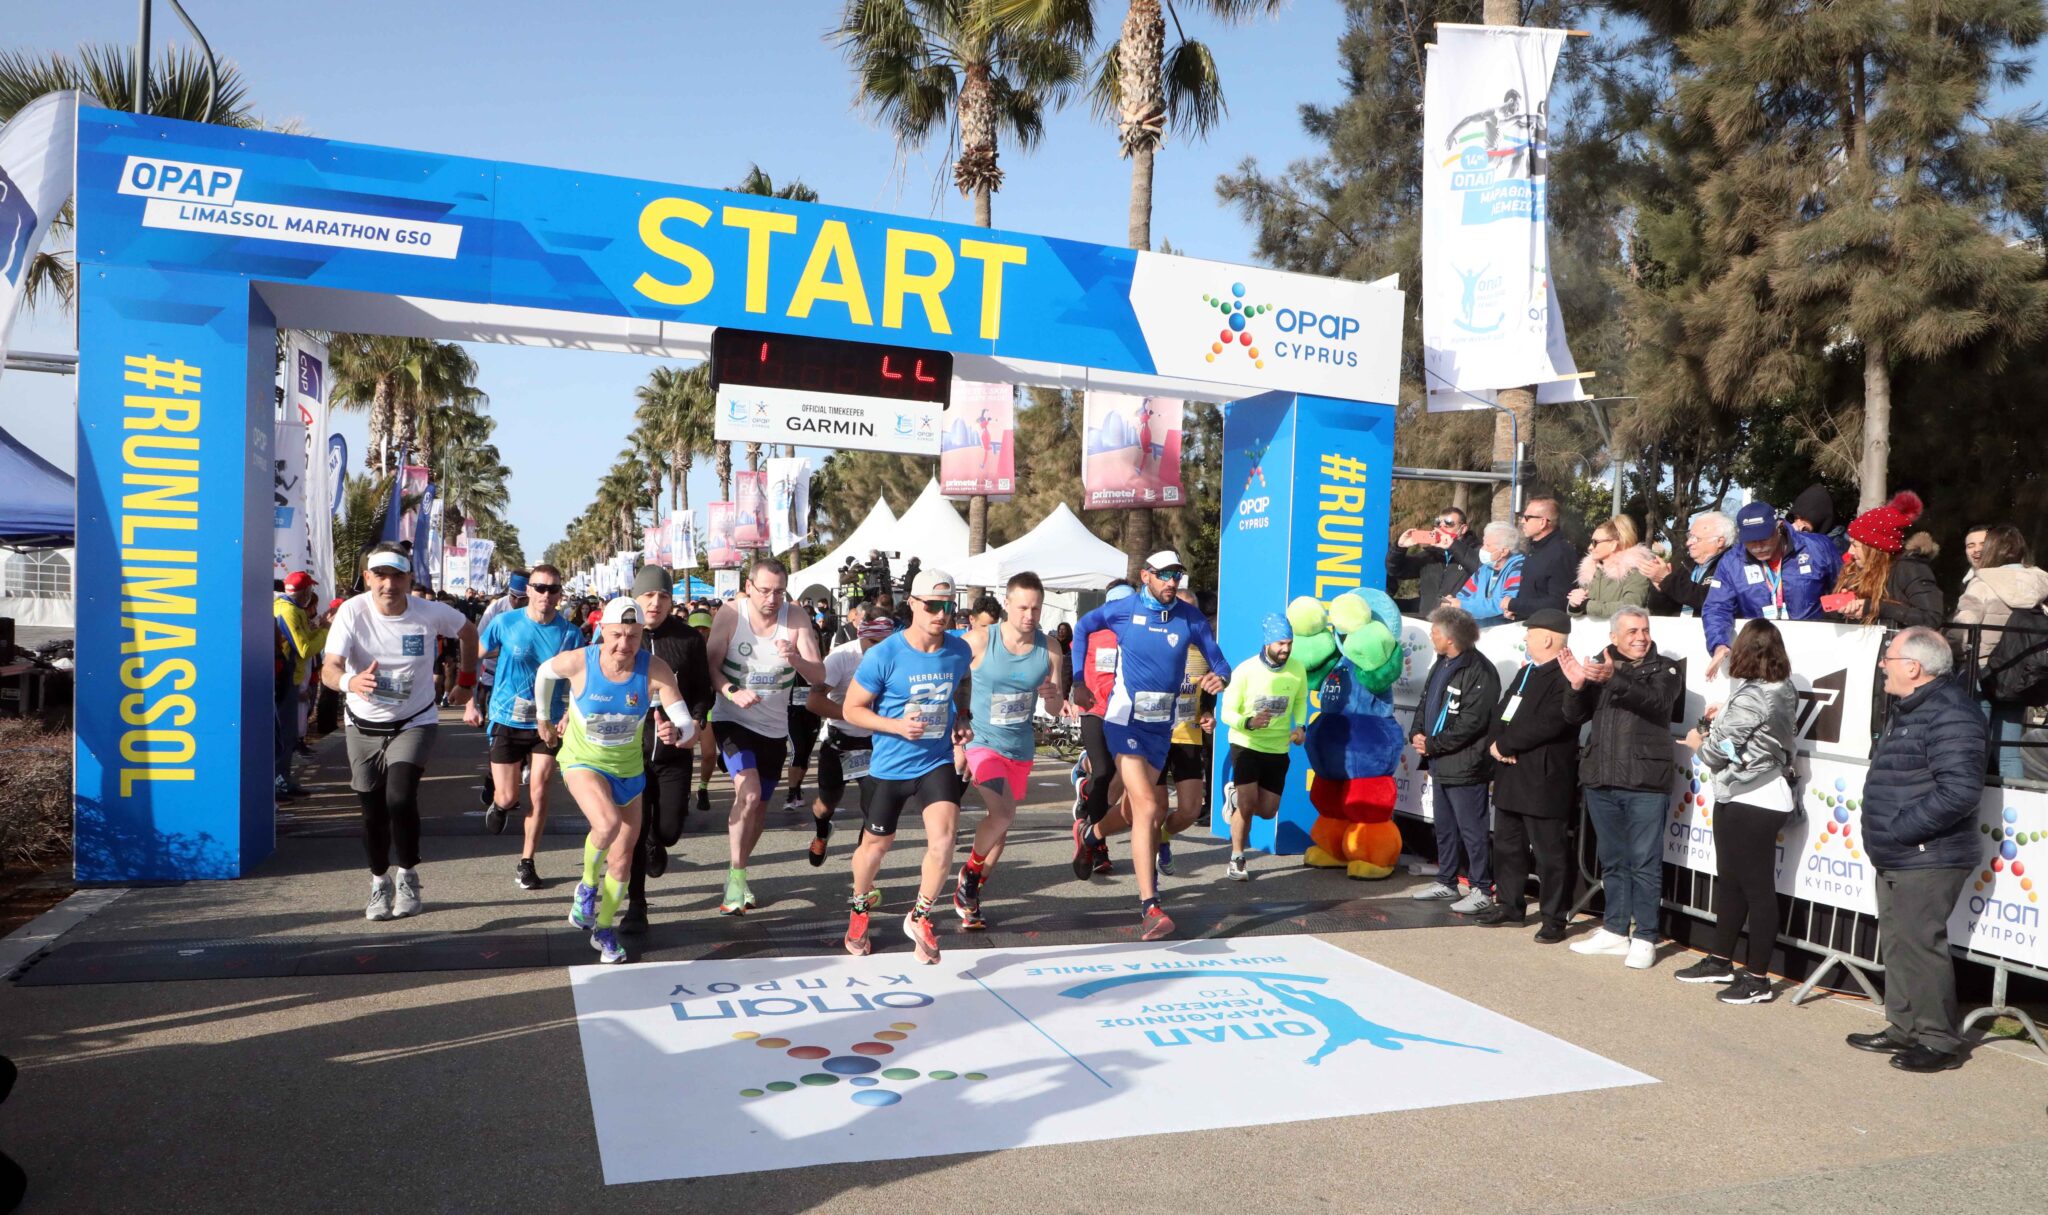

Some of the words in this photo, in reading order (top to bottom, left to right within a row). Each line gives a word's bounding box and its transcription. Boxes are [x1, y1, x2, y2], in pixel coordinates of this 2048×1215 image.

[131, 162, 233, 198] OPAP
[179, 205, 279, 230] LIMASSOL
[284, 216, 390, 242] MARATHON
[395, 228, 432, 246] GSO
[632, 196, 1028, 340] START
[1274, 341, 1358, 368] CYPRUS
[301, 355, 309, 392] CNP
[802, 403, 827, 414] OFFICIAL
[828, 405, 865, 417] TIMEKEEPER
[786, 416, 874, 437] GARMIN
[1092, 487, 1136, 501] primetel
[1238, 516, 1270, 531] CYPRUS
[119, 353, 202, 799] #RUNLIMASSOL
[749, 676, 776, 685] 2909
[908, 672, 955, 683] HERBALIFE
[597, 724, 628, 736] 2957
[1669, 842, 1711, 860] ΚΥΠΡΟΥ
[1805, 877, 1862, 897] ΚΥΠΡΟΥ
[1967, 920, 2037, 948] ΚΥΠΡΟΥ
[1023, 963, 1116, 977] SMILE
[1150, 958, 1226, 972] WITH
[1230, 955, 1288, 966] RUN
[670, 974, 913, 996] ΚΥΠΡΟΥ
[1140, 997, 1264, 1014] ΛΕΜΕΣΟΥ
[1096, 1006, 1288, 1028] ΜΑΡΑΘΩΝΙΟΣ
[1142, 1018, 1316, 1048] ΟΠΑΠ
